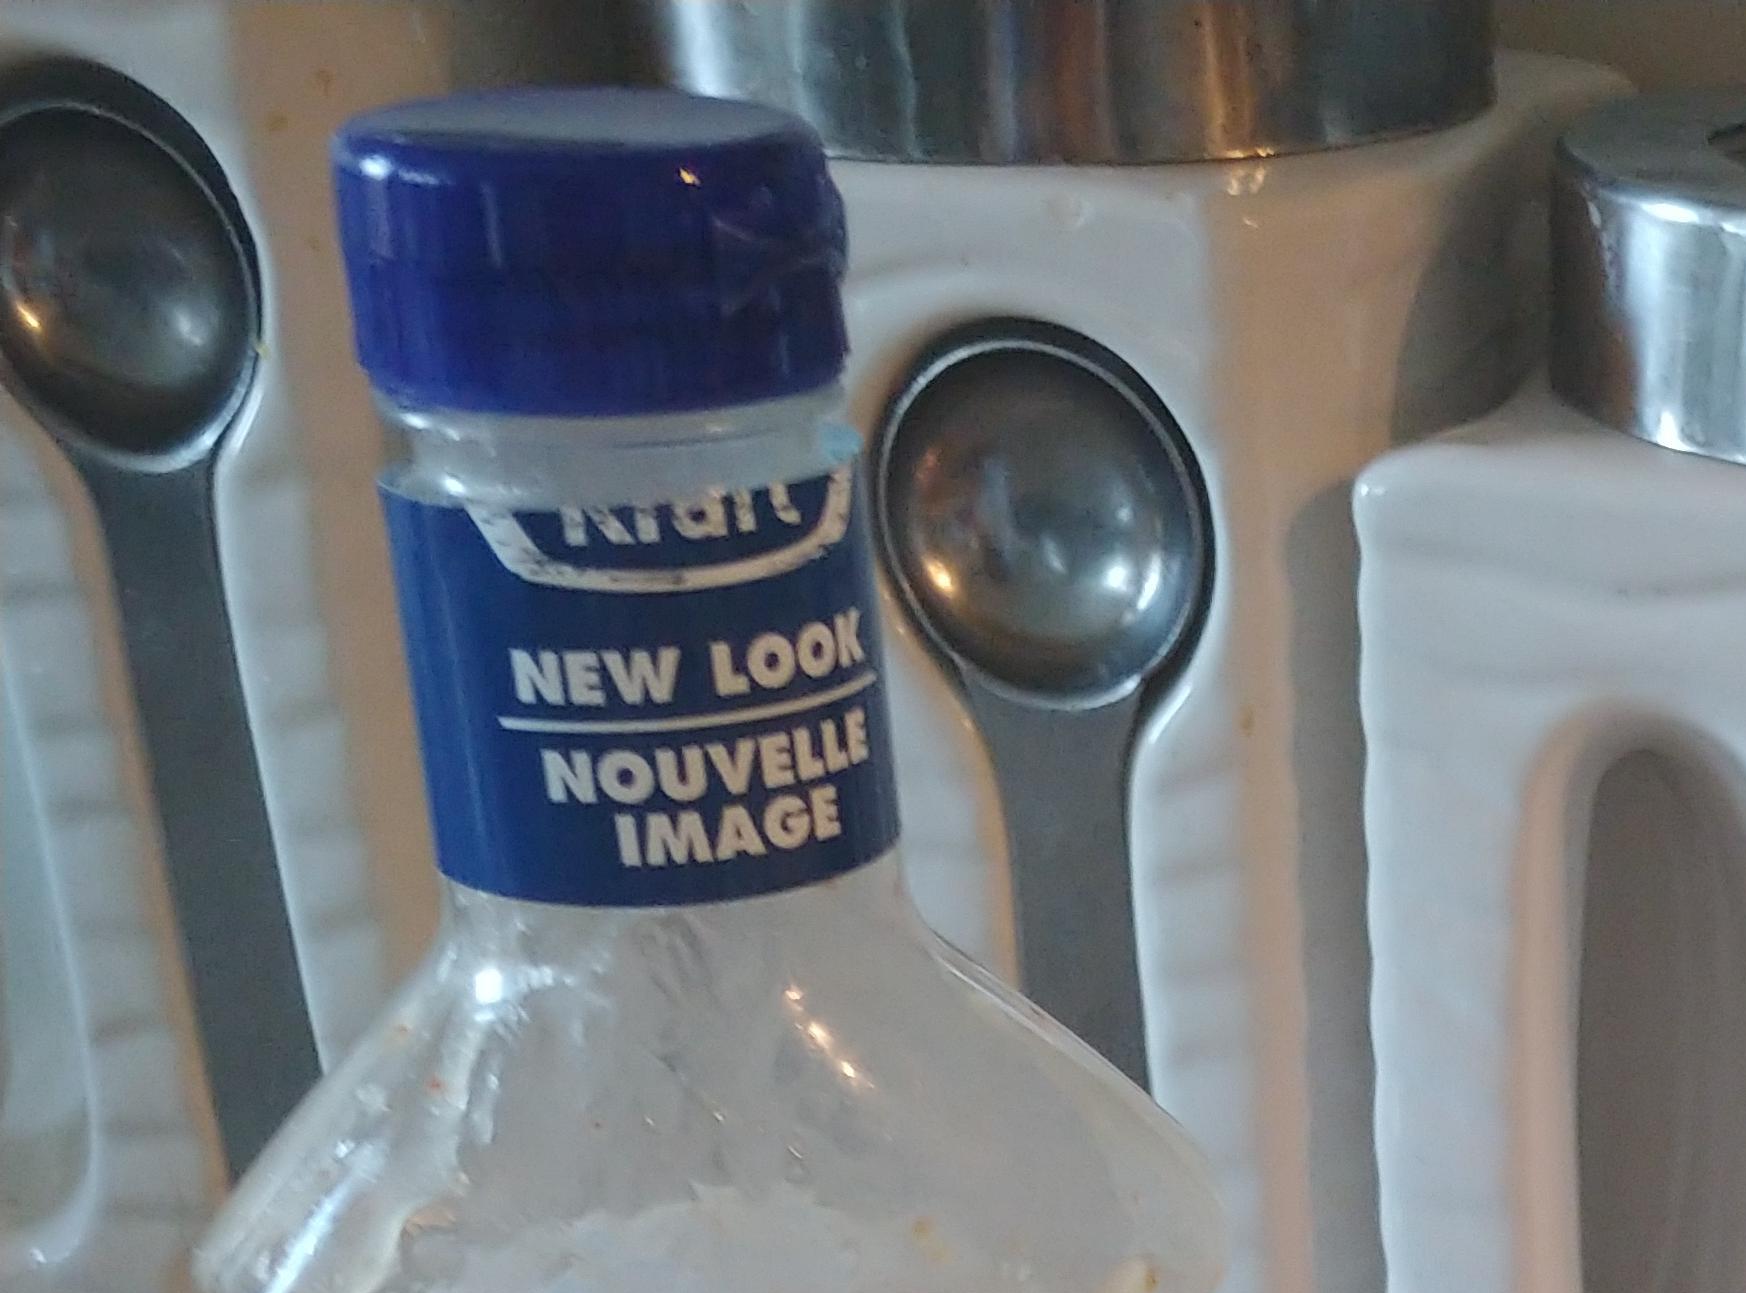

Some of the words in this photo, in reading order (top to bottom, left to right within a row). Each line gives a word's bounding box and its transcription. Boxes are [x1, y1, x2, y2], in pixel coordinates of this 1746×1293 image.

[509, 645, 680, 705] NEW
[710, 608, 866, 697] LOOK
[539, 708, 869, 804] NOUVELLE
[614, 785, 842, 867] IMAGE
